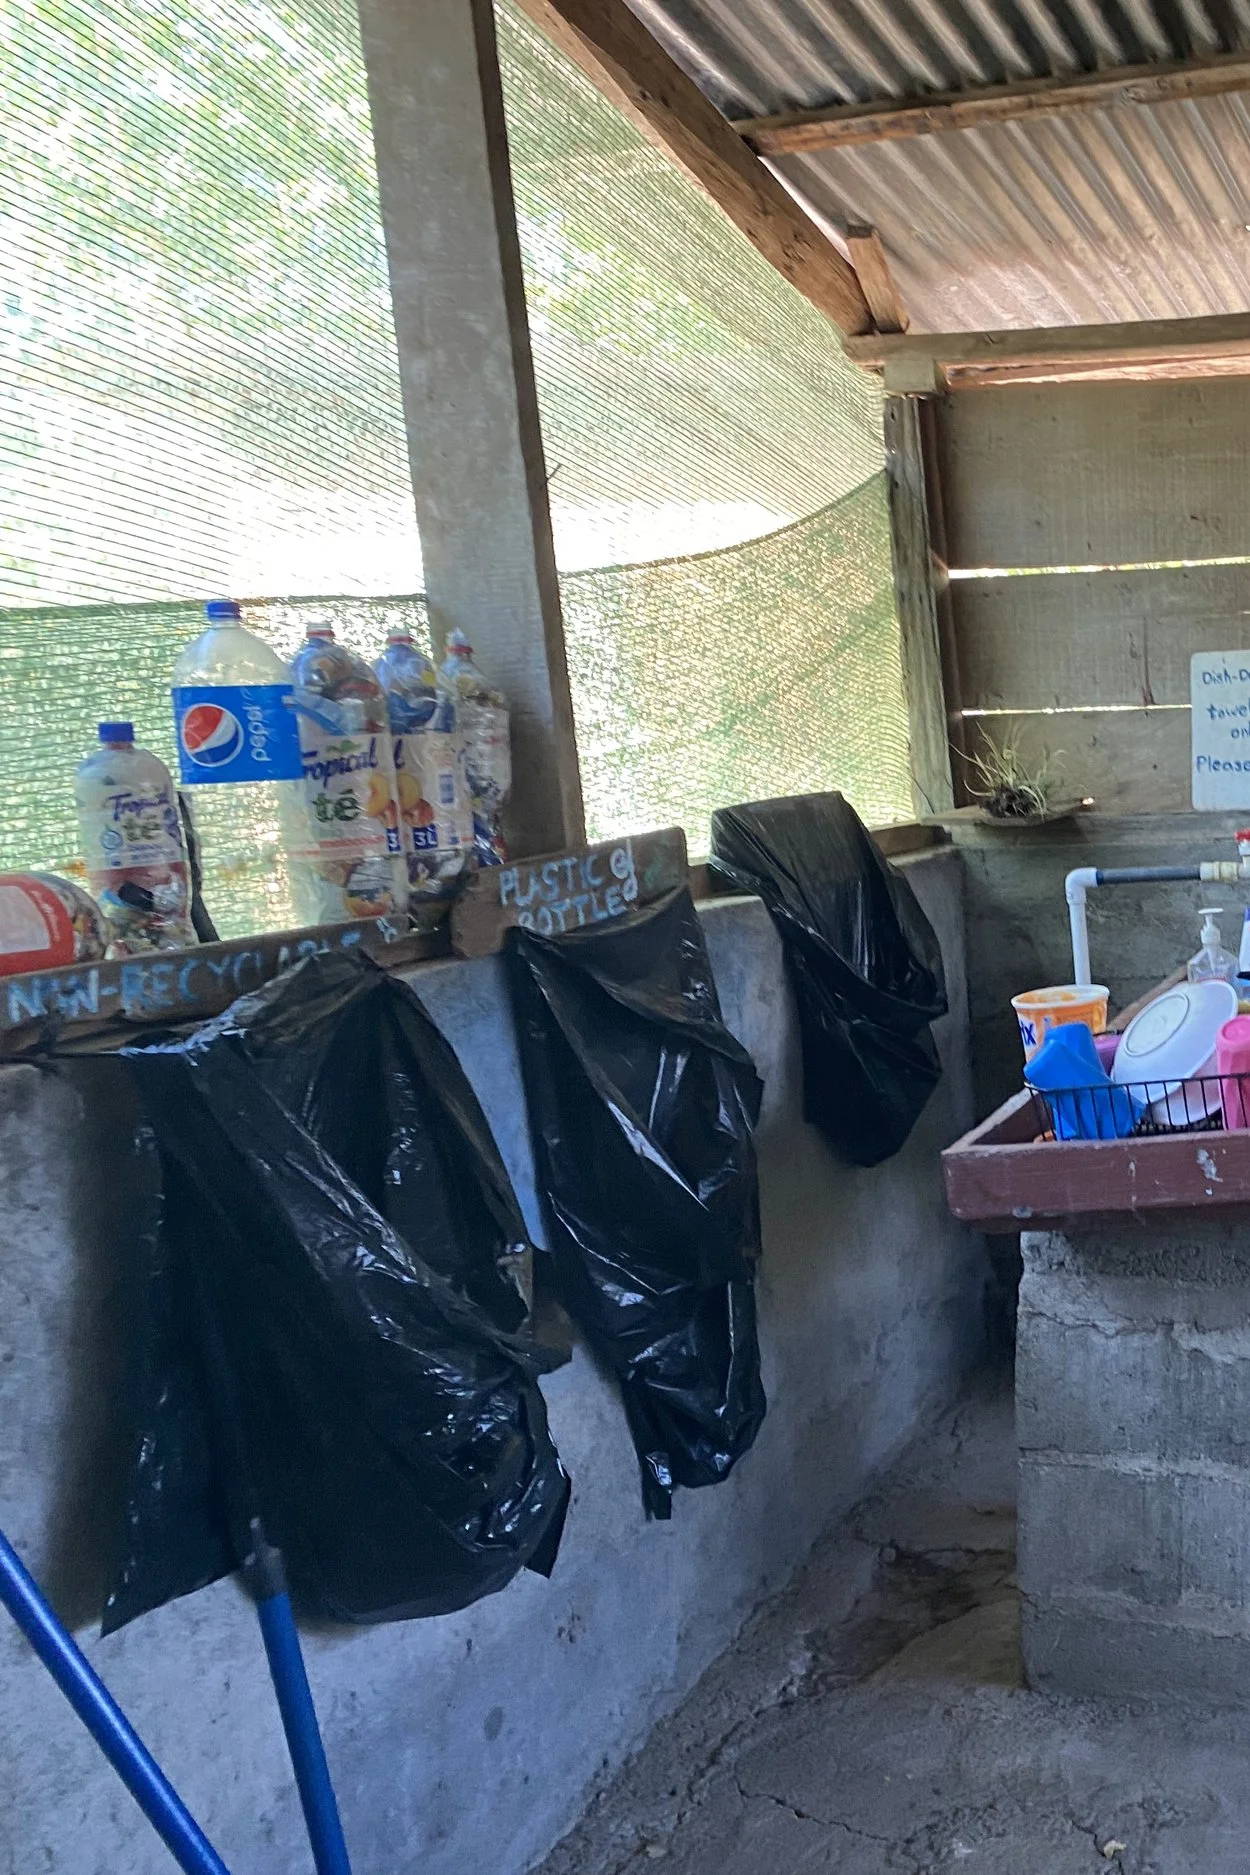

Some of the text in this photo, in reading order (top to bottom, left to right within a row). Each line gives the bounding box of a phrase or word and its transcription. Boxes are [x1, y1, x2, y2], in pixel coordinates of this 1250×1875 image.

[242, 702, 272, 761] pepsi
[313, 788, 360, 823] té
[415, 829, 437, 847] 3L
[500, 854, 604, 907] PLASTIC
